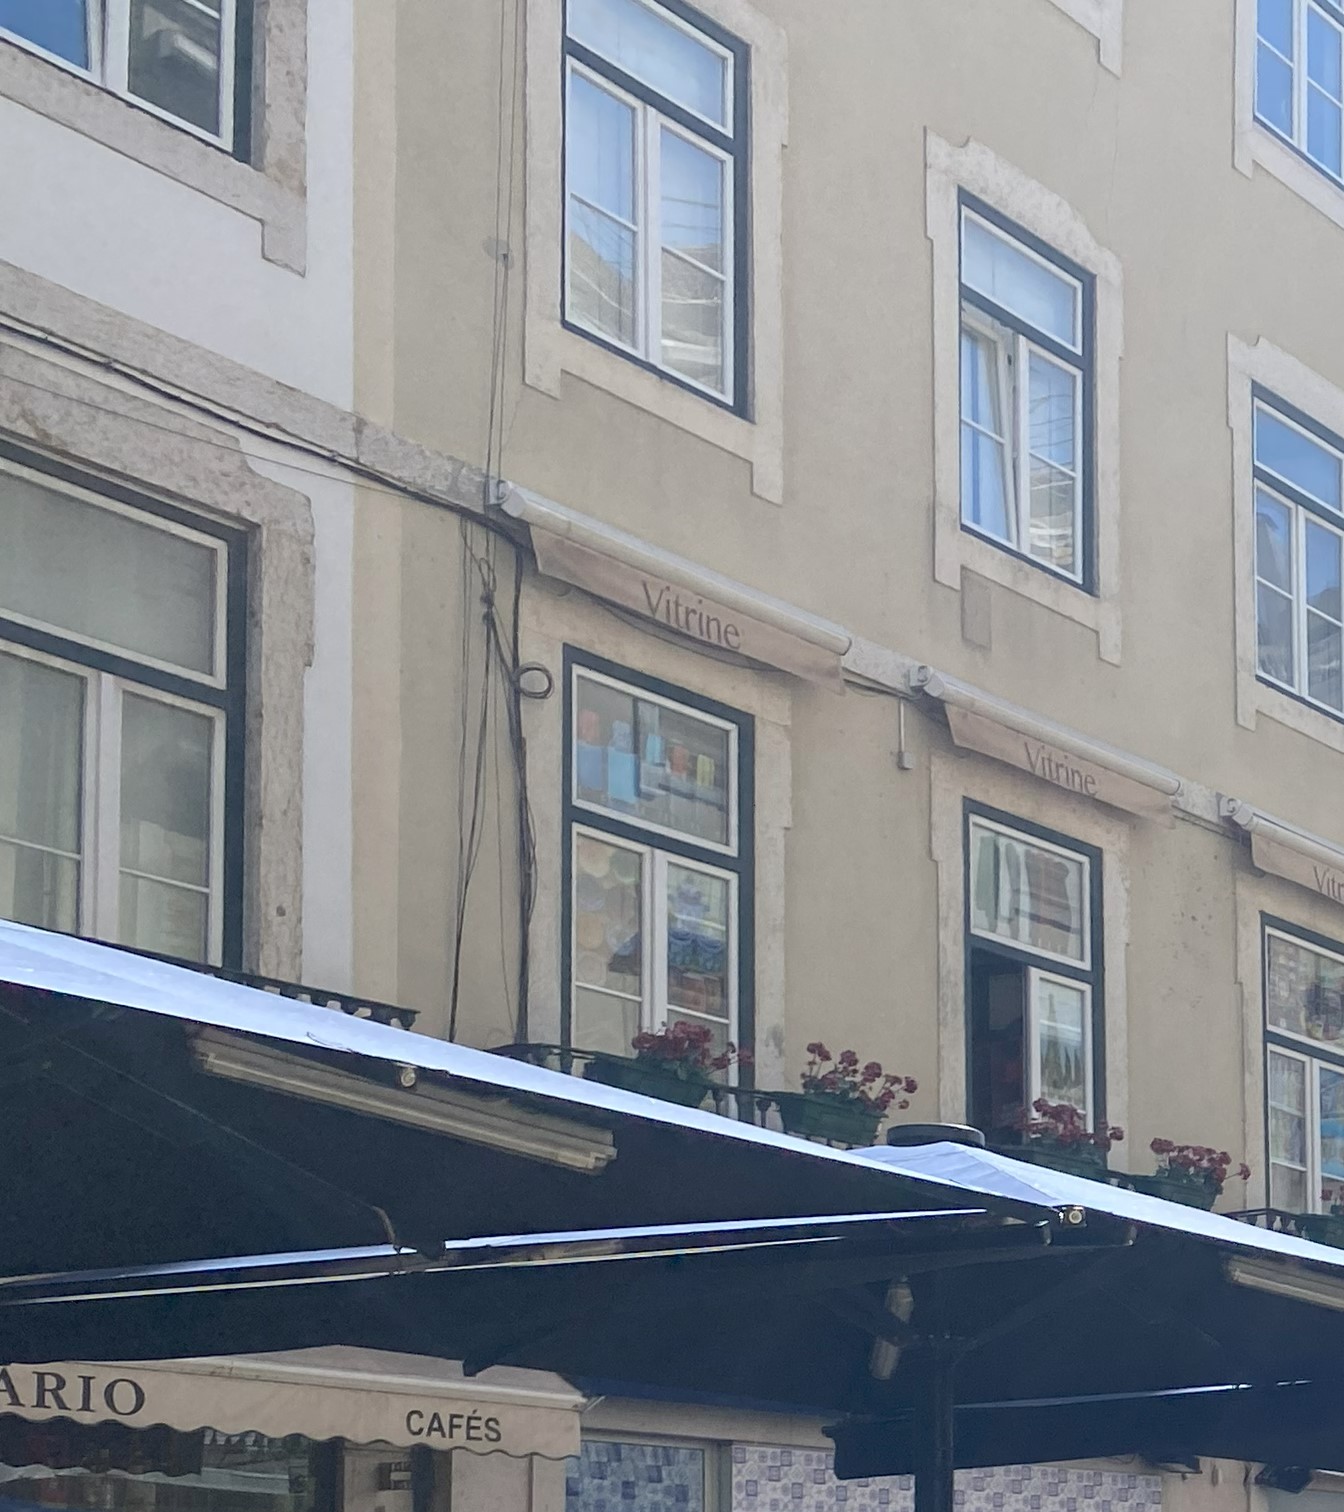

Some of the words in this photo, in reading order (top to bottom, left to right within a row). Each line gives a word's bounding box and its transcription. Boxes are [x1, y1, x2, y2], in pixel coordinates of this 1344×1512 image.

[642, 579, 741, 650] Vitrine
[1023, 741, 1097, 797] Vitrine
[0, 1367, 146, 1416] ARIO
[405, 1408, 502, 1443] CAFÉS
